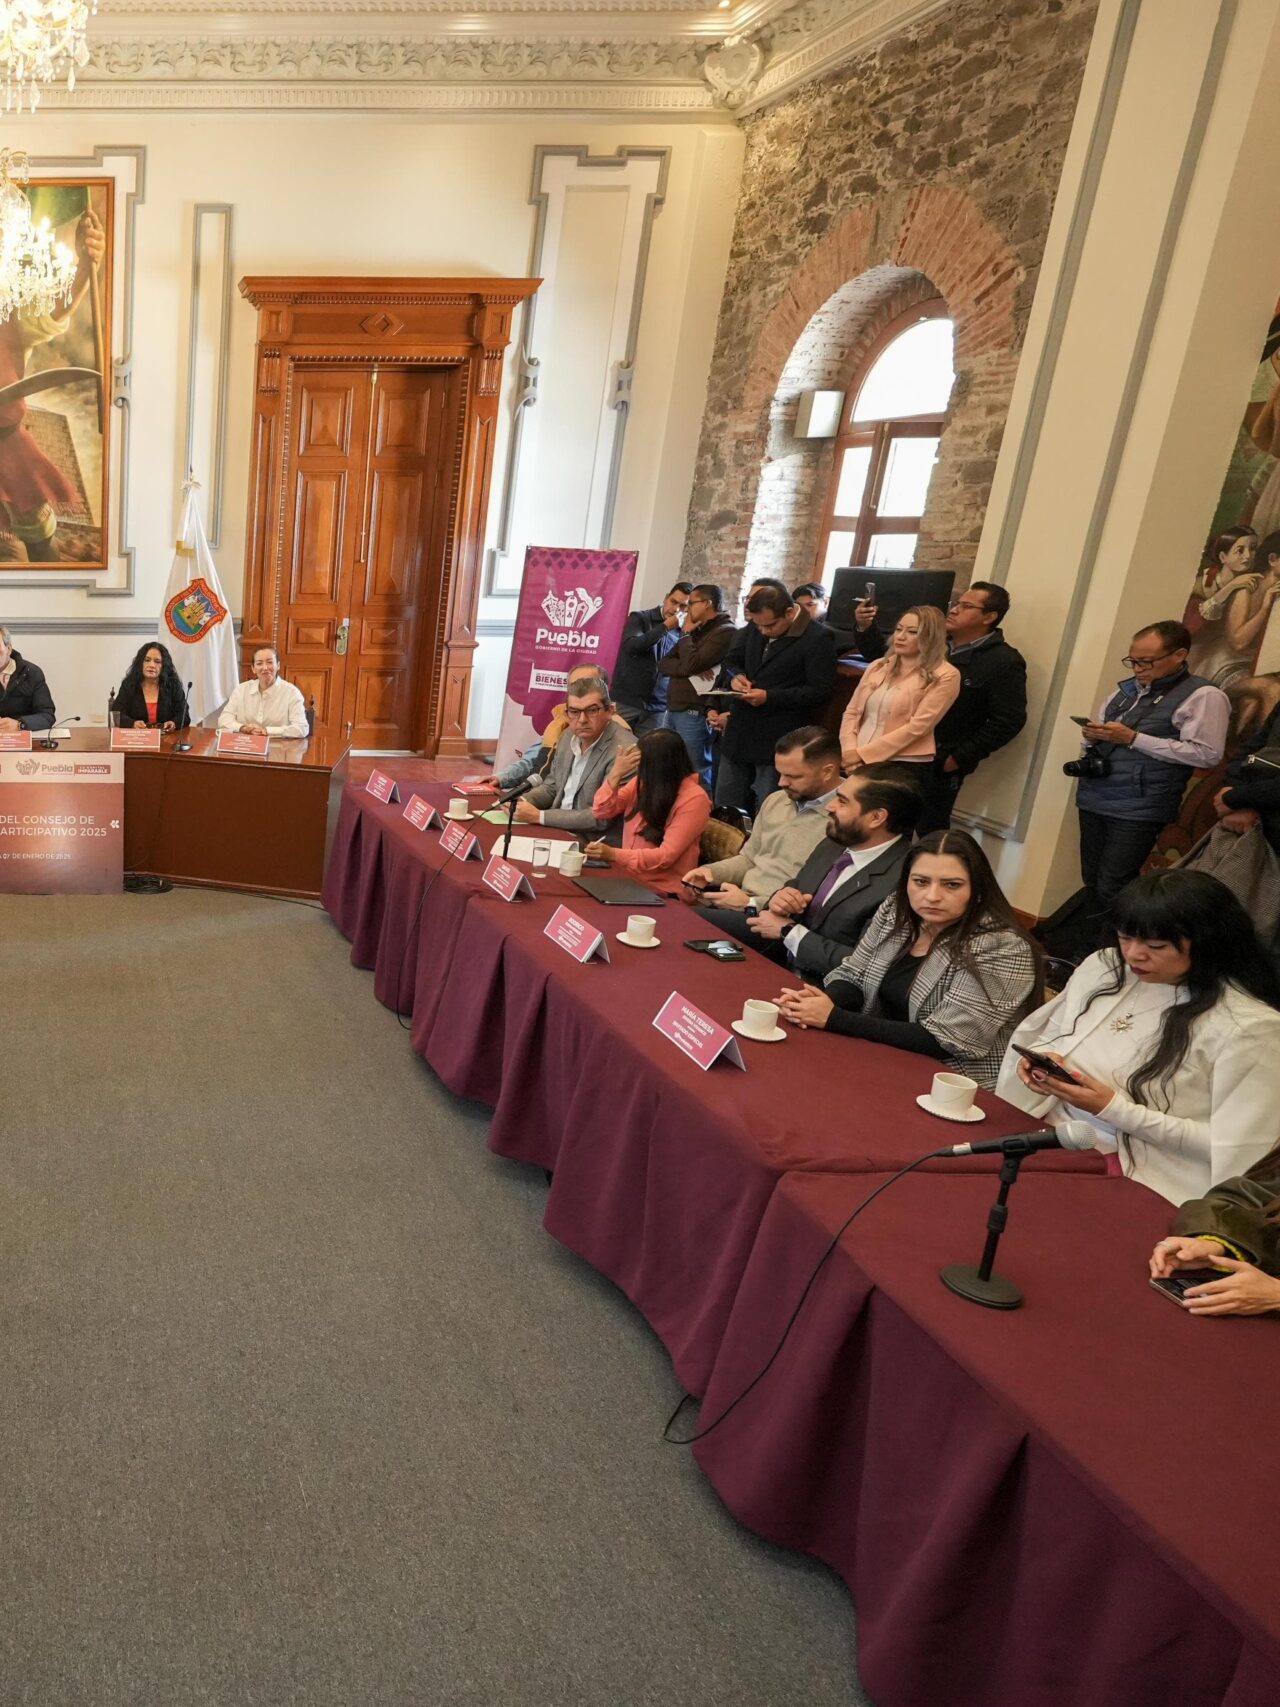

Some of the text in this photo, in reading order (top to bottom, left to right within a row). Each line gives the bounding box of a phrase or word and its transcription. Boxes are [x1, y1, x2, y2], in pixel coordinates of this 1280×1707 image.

[536, 628, 600, 648] Puebla
[41, 764, 73, 772] Puebla
[0, 816, 20, 824] DEL
[22, 816, 77, 825] CONSEJO
[80, 816, 95, 825] DE
[80, 828, 107, 837] 2025
[681, 1005, 714, 1035] MARÍA TERESA
[688, 1032, 704, 1049] ESPECIAL
